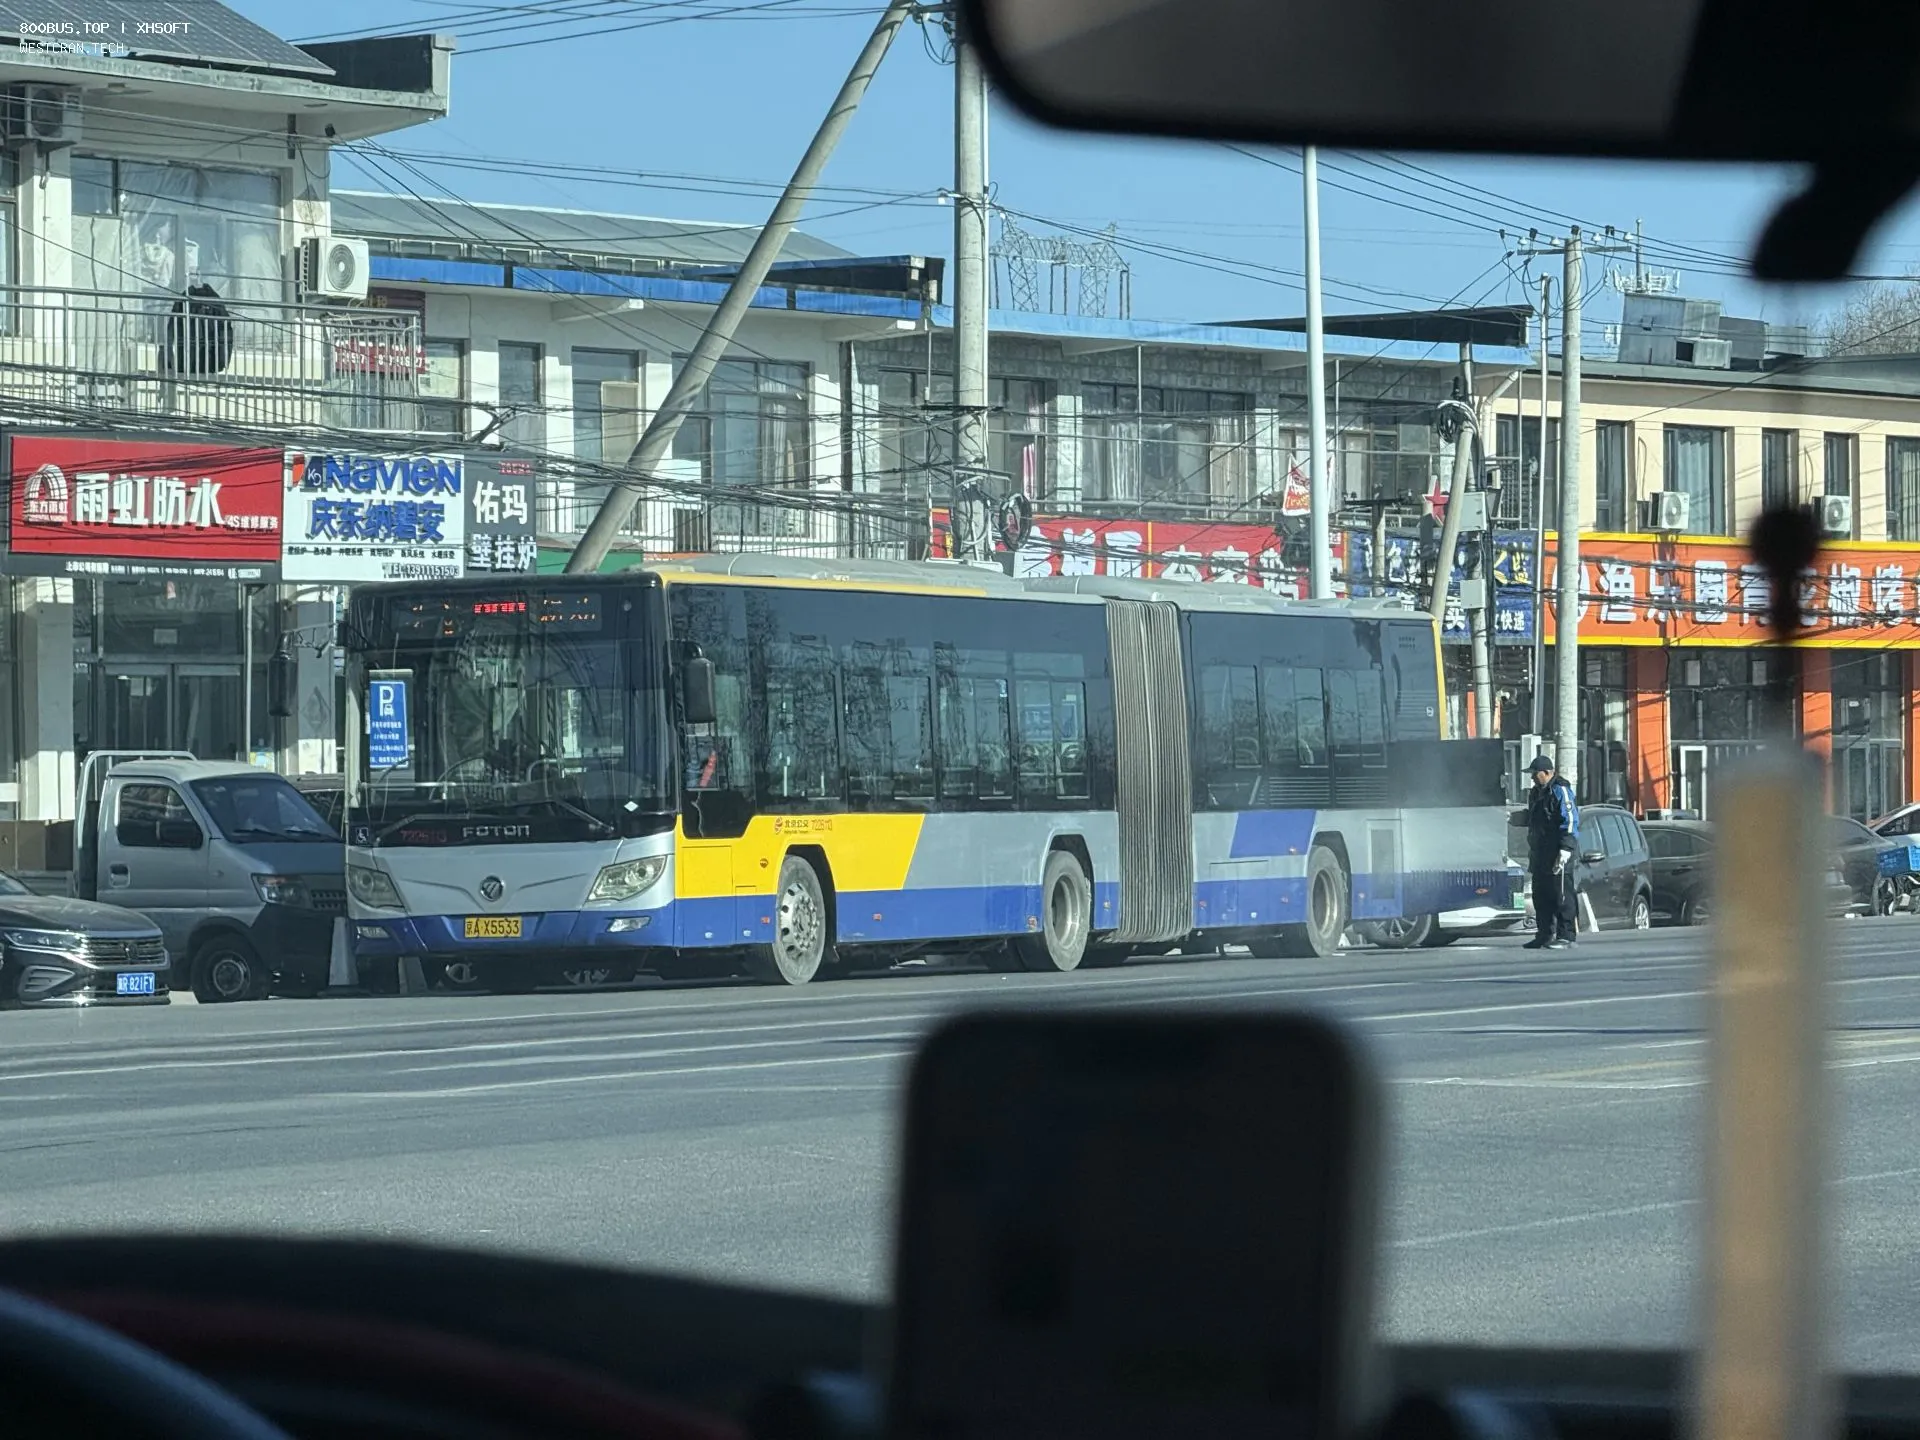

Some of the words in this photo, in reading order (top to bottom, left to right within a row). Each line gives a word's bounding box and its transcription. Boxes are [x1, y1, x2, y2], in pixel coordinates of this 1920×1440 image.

[75, 472, 225, 528] 雨虹防水
[472, 481, 528, 525] 佑玛
[470, 534, 537, 571] 壁挂炉
[462, 825, 530, 838] FOTON
